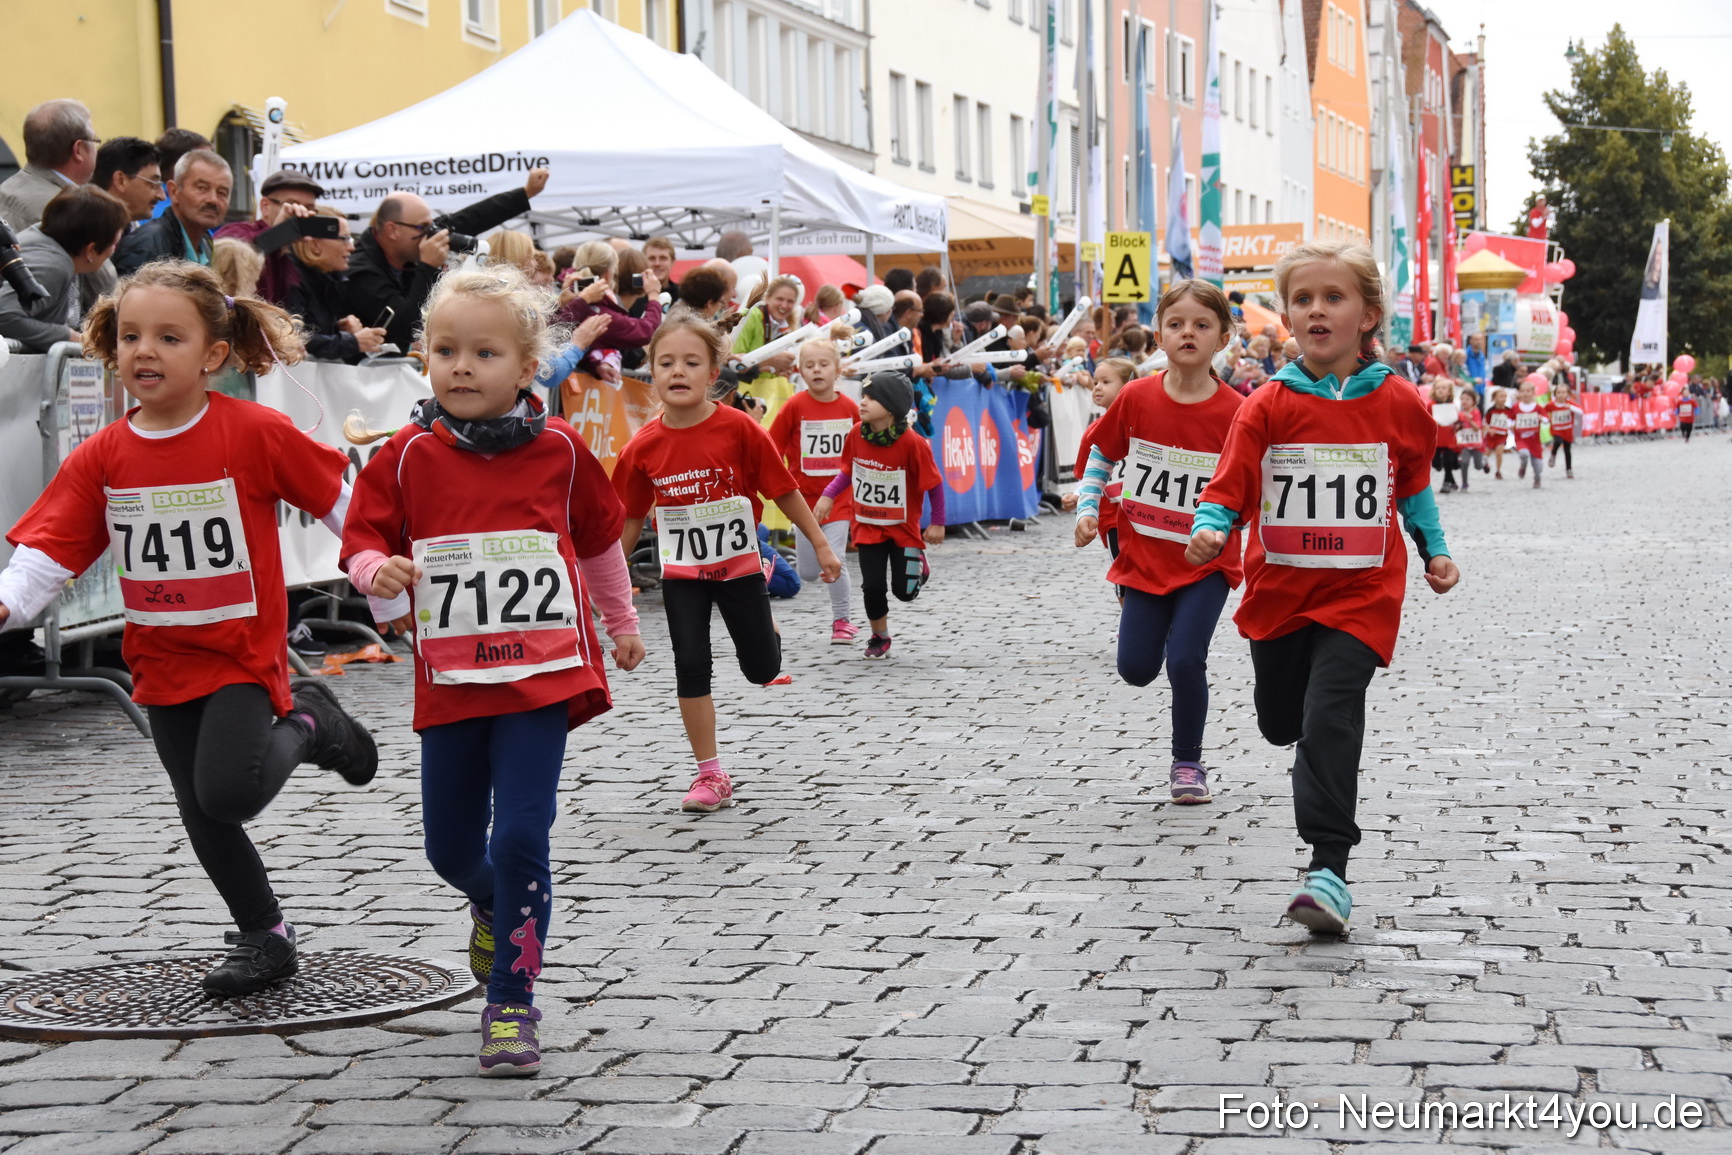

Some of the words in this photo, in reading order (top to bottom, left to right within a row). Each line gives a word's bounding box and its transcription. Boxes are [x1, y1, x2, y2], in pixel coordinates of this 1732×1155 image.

[355, 153, 550, 179] ConnectedDrive
[363, 187, 389, 199] um
[424, 185, 443, 196] zu
[448, 180, 488, 195] sein.
[1110, 235, 1146, 248] Block
[1113, 253, 1140, 287] A
[1168, 451, 1217, 469] BOCK
[1314, 448, 1378, 463] BOCK
[152, 486, 225, 509] BOCK
[855, 477, 900, 505] 7254
[1273, 474, 1378, 520] 7118
[1384, 459, 1395, 528] AMBINI
[694, 500, 744, 519] BOCK
[860, 507, 887, 518] Sophia
[1127, 504, 1155, 521] Laura
[1163, 516, 1189, 529] Sophie
[113, 516, 235, 572] 7419
[423, 551, 473, 564] NeuerMarkt
[482, 535, 555, 556] BOCK
[669, 518, 748, 561] 7073
[1302, 533, 1344, 551] Finia
[143, 583, 186, 604] Lea
[430, 567, 564, 629] 7122
[475, 642, 524, 663] Anna
